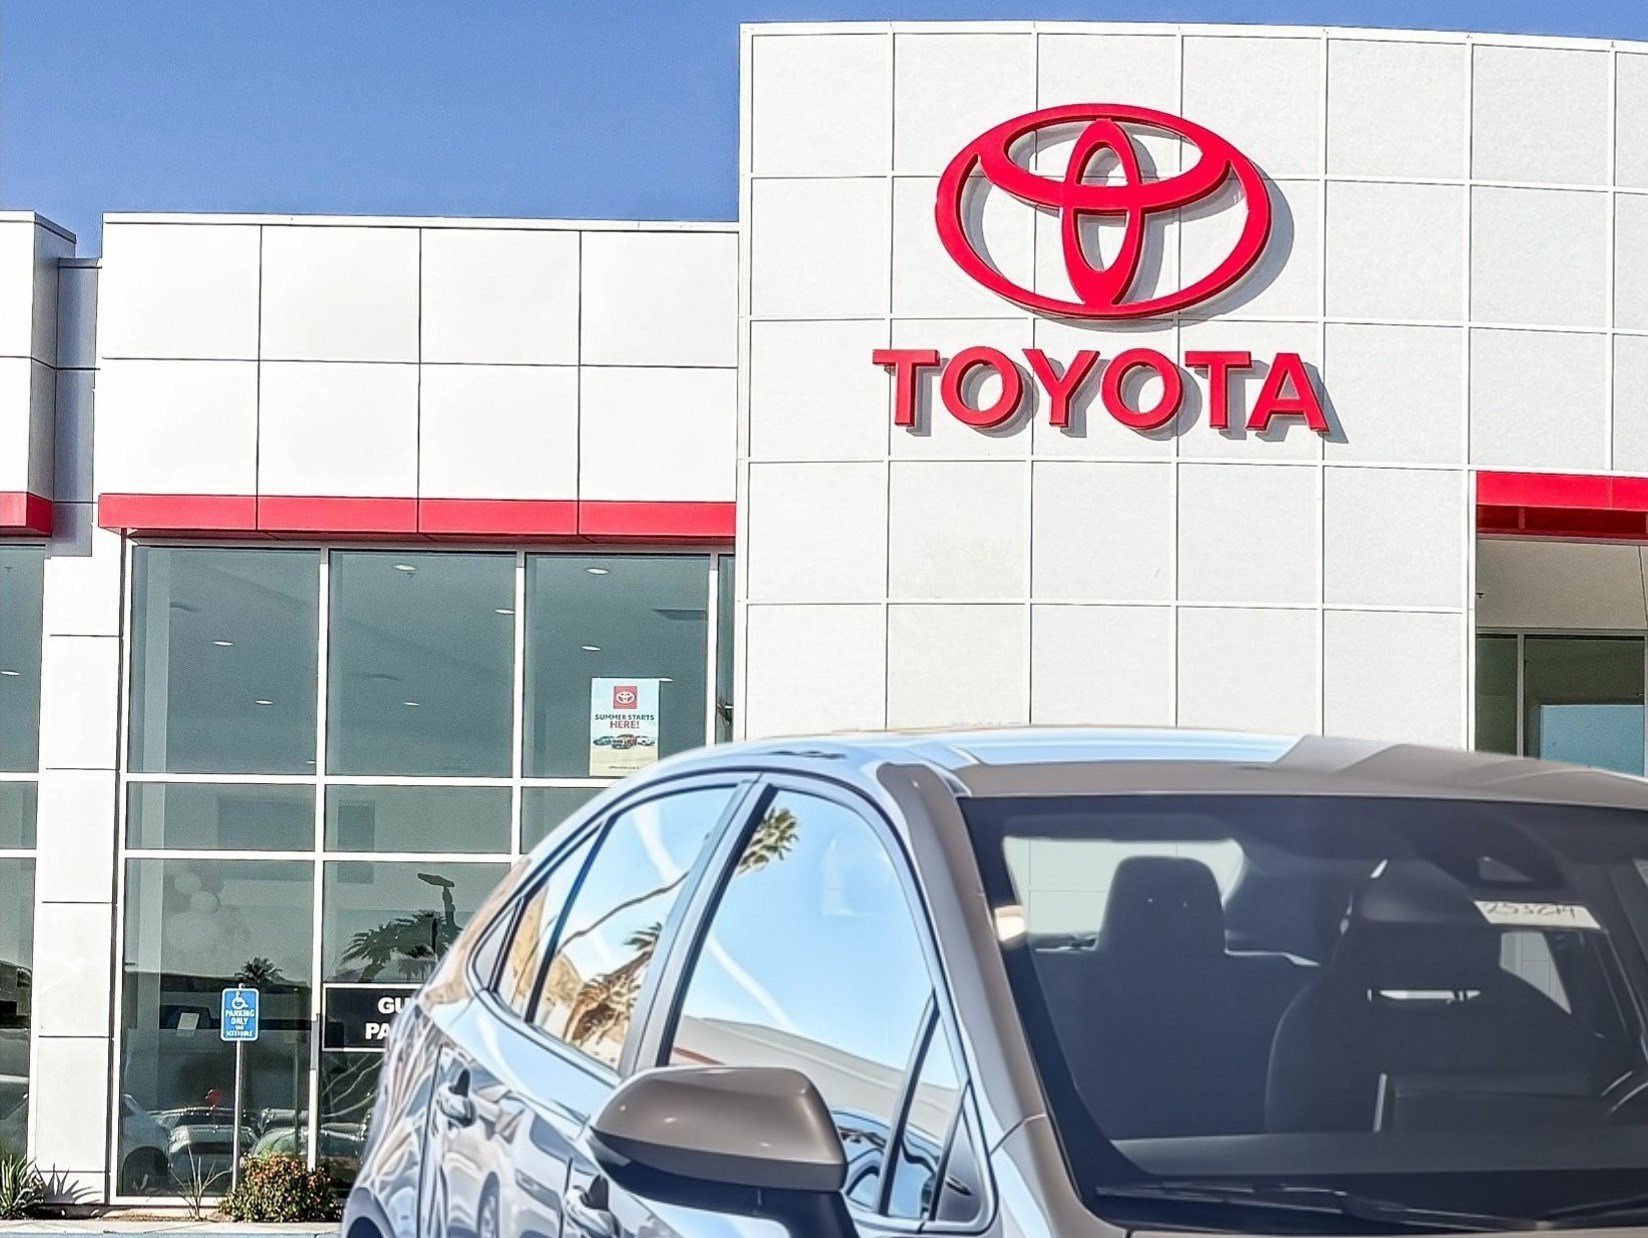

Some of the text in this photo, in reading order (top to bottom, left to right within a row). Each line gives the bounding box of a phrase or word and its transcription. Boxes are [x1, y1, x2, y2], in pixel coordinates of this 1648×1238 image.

[873, 346, 1330, 432] TOYOTA
[609, 720, 640, 729] HERE!
[225, 1009, 255, 1017] PARKING
[230, 1017, 249, 1025] ONLY
